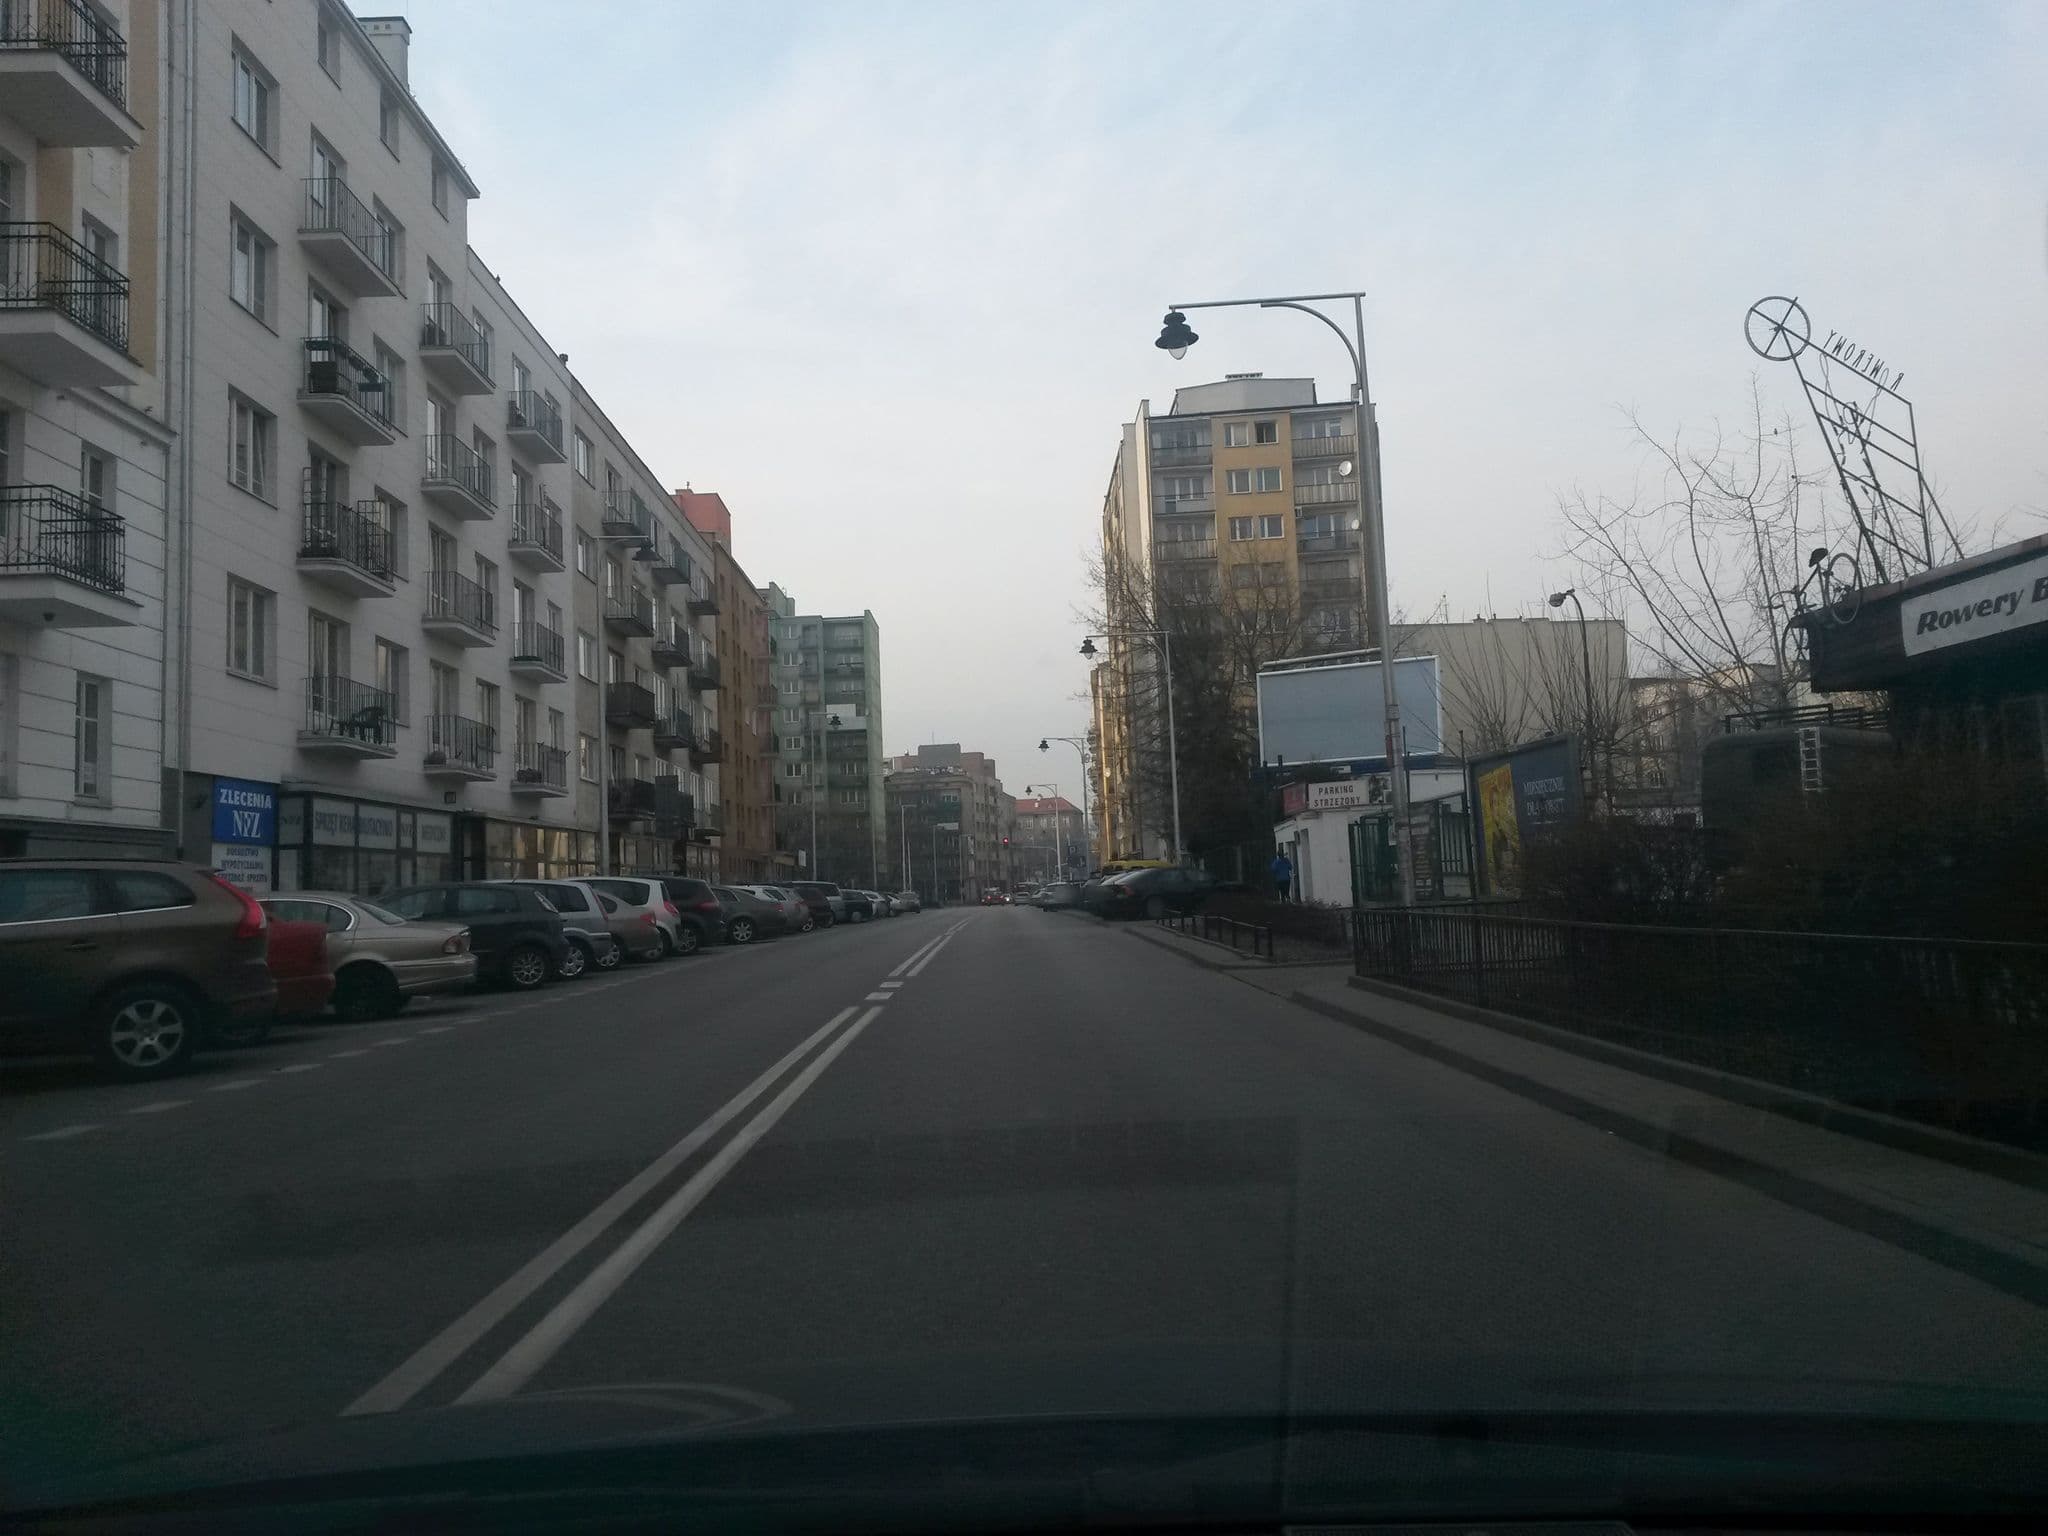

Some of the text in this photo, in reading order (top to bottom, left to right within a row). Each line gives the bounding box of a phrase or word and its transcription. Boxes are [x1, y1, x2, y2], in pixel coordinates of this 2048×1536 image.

[1917, 589, 2025, 635] Rowery
[219, 788, 272, 809] ZLECENIA
[1318, 785, 1354, 795] PARKING
[232, 810, 261, 838] NFZ
